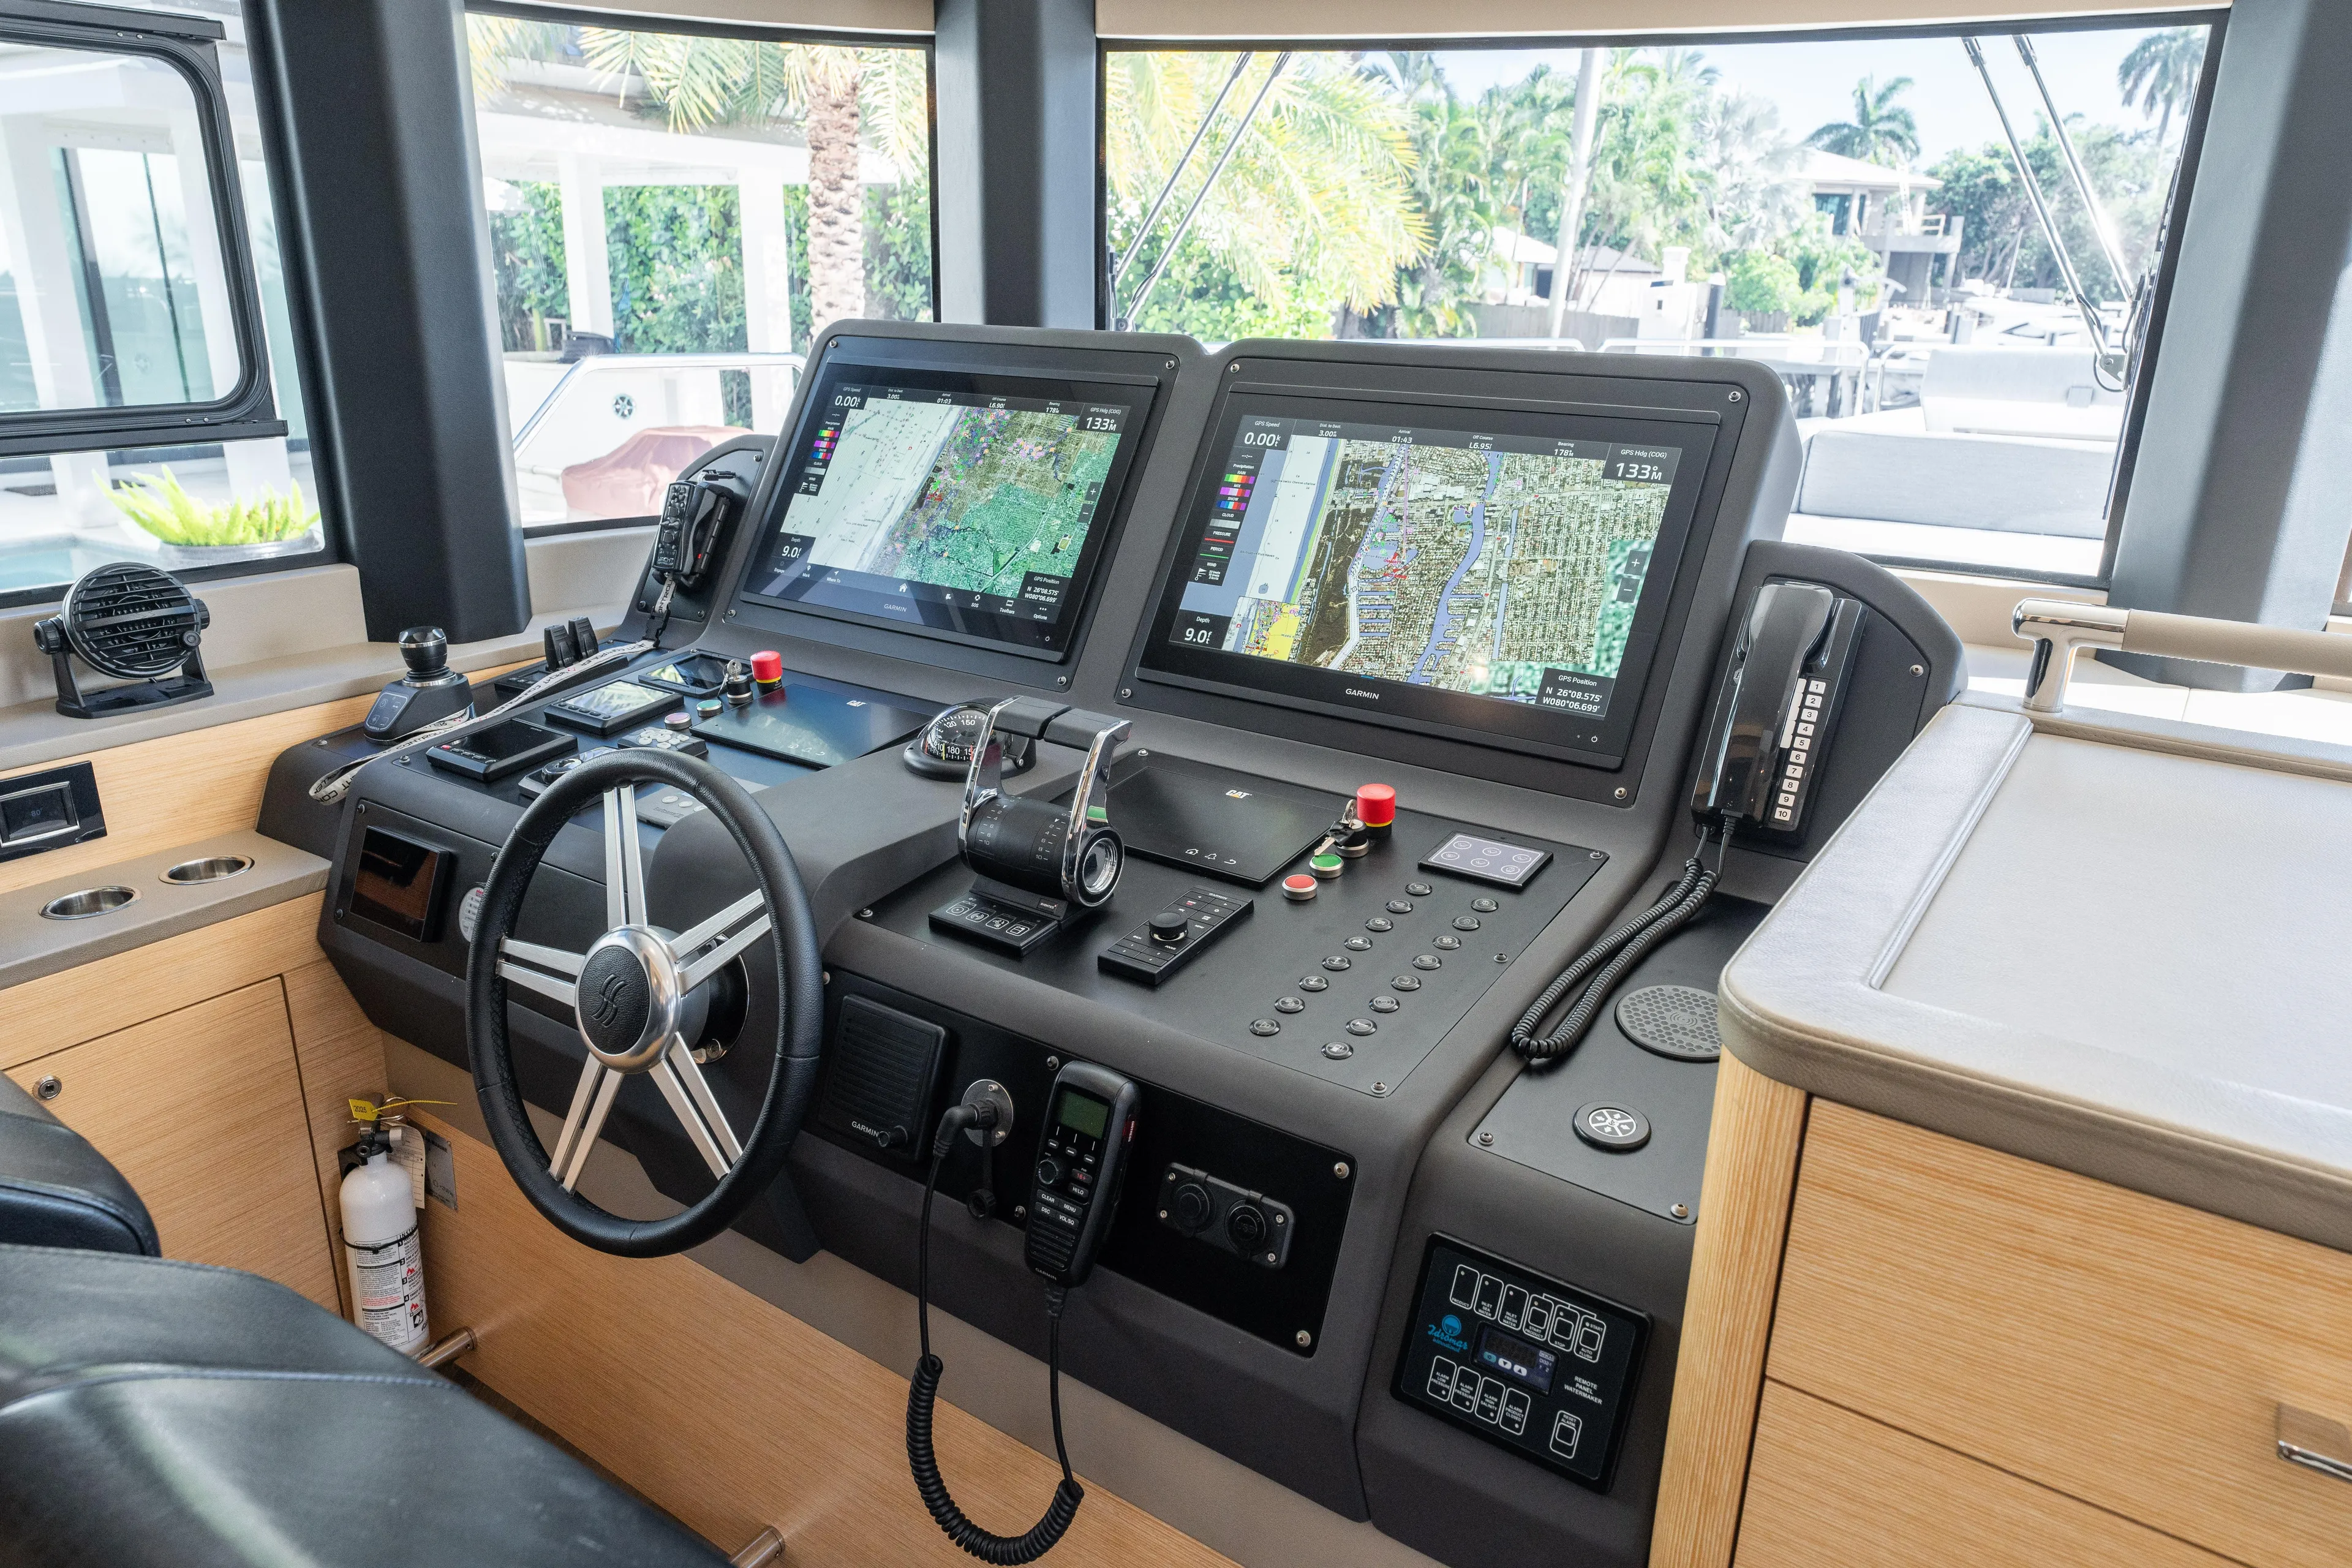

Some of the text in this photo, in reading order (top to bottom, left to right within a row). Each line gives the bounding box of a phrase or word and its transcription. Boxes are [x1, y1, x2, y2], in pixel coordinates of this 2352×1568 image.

[884, 603, 907, 612] GARMIN
[1572, 677, 1597, 687] Position
[1346, 688, 1379, 699] GARMIN
[933, 742, 960, 755] 210 180
[1226, 790, 1250, 799] CAT
[851, 1121, 879, 1137] GARMIN
[1072, 1186, 1084, 1195] HI/LO
[1041, 1193, 1076, 1213] CLEAR MENU
[1059, 1215, 1074, 1225] VOL/SQ
[1035, 1267, 1057, 1281] GARMIN
[1451, 1297, 1471, 1308] PRODUCT
[1478, 1308, 1492, 1317] WATER
[1502, 1319, 1517, 1328] WATER
[1504, 1315, 1518, 1324] FRESH
[1529, 1325, 1542, 1334] START
[1589, 1323, 1604, 1332] START
[1524, 1328, 1544, 1339] PRODUCT
[1578, 1350, 1593, 1360] FLUSH
[1581, 1347, 1593, 1355] AUTO
[1436, 1371, 1449, 1381] ALARM
[1431, 1378, 1450, 1390] PRESSURE
[1460, 1382, 1473, 1391] ALARM
[1575, 1376, 1598, 1390] REMOTE
[1575, 1383, 1594, 1395] PANEL
[1455, 1389, 1474, 1401] PRESSURE
[1483, 1393, 1498, 1402] ALARM
[1564, 1384, 1603, 1405] WATERMAKER
[1480, 1400, 1498, 1411] SALINITY
[1509, 1404, 1523, 1413] ALARM
[1505, 1407, 1524, 1418] PRODUCT
[1506, 1412, 1521, 1422] CLOSED
[1561, 1418, 1576, 1428] ALARM
[1563, 1414, 1577, 1423] RESET
